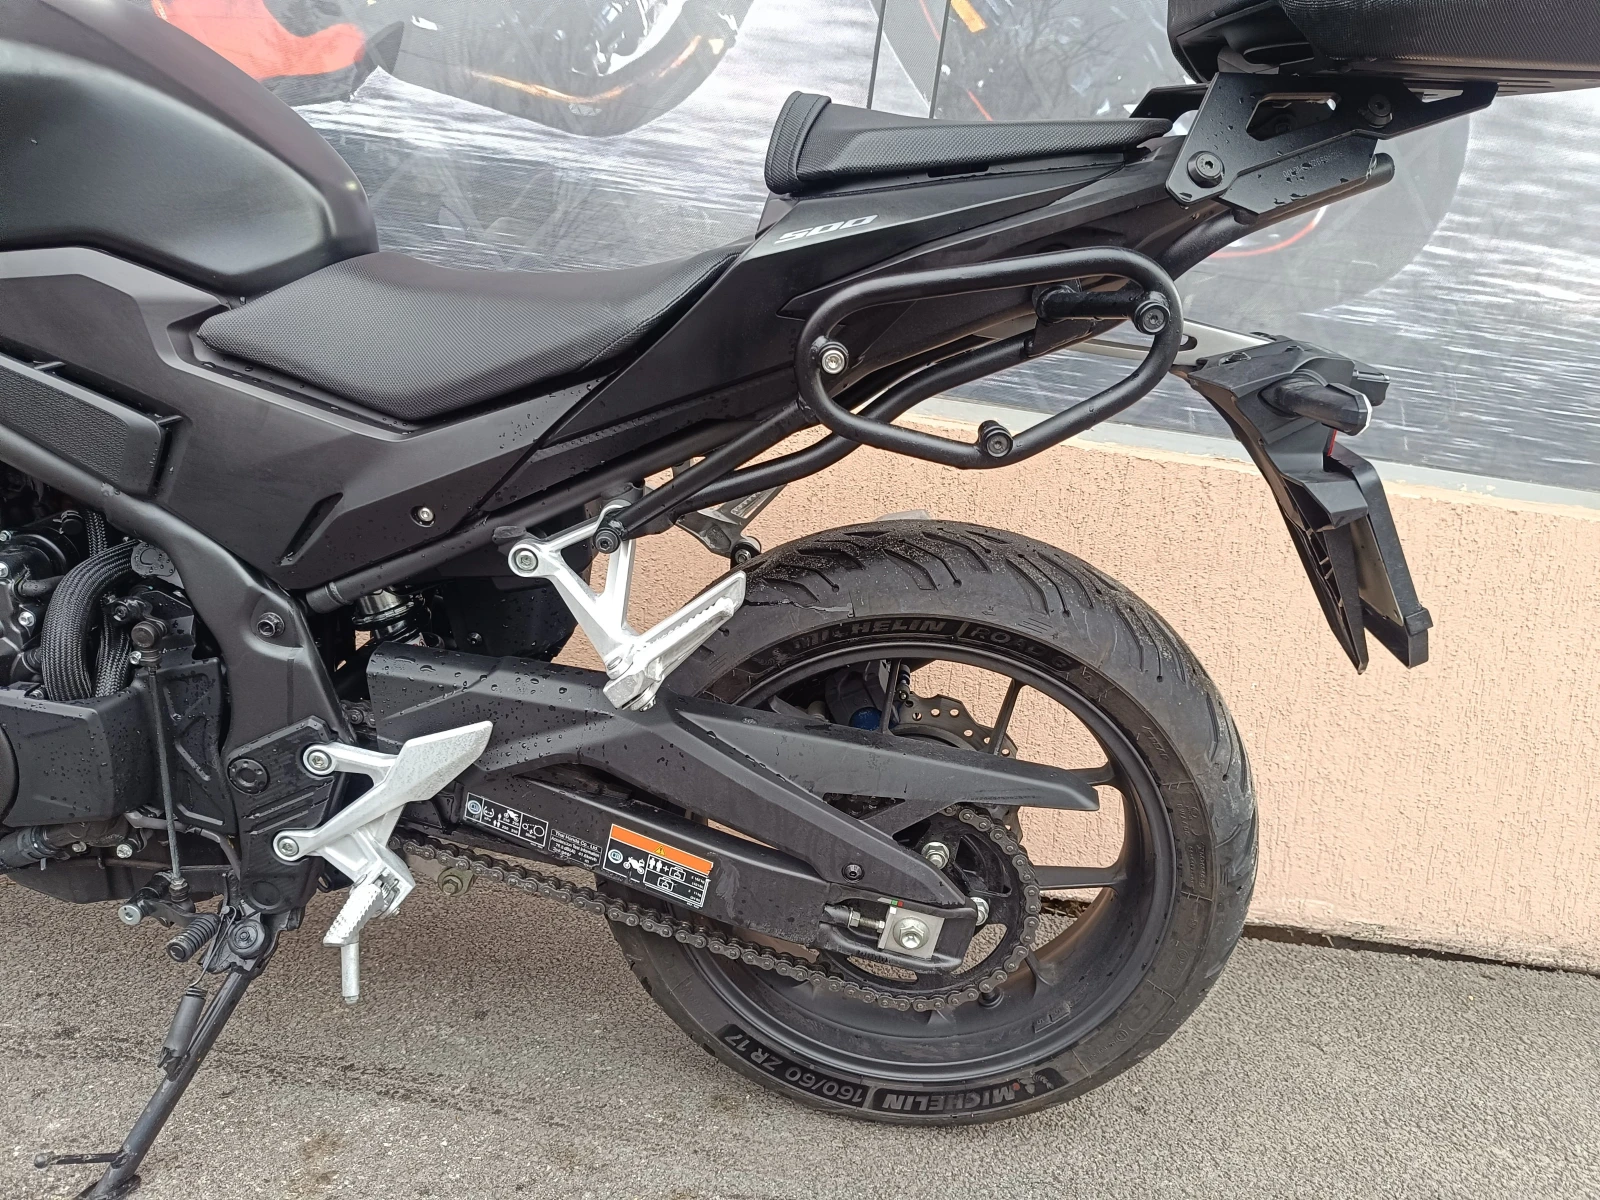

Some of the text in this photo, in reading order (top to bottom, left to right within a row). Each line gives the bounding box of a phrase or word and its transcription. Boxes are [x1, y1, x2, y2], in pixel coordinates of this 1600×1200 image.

[774, 214, 878, 244] 500
[723, 1033, 1016, 1112] MICHELIN 160/60 ZR 17
